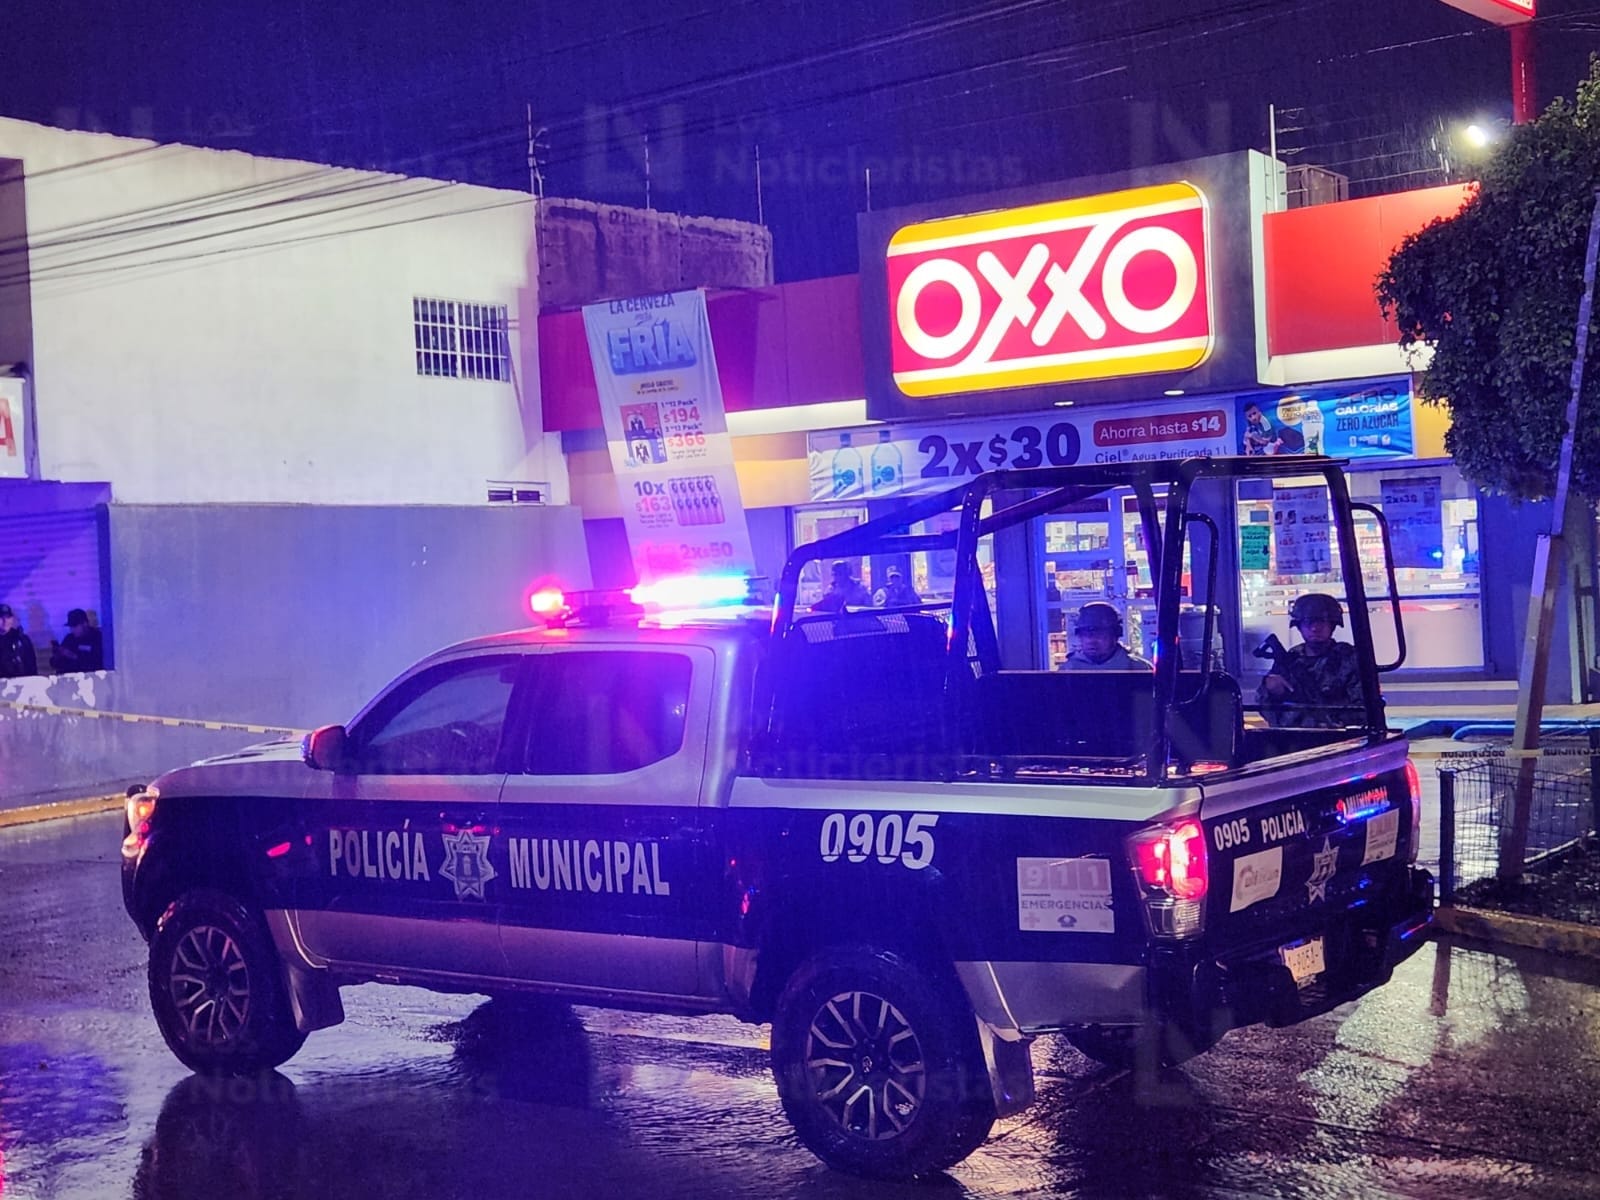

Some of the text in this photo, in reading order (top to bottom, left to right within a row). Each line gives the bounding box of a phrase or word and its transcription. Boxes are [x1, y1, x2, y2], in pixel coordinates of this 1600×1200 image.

[897, 225, 1197, 361] OXXO
[608, 319, 696, 371] FRÍA
[663, 406, 700, 423] $194
[1336, 416, 1360, 432] ZERO
[668, 431, 705, 448] $366
[1100, 415, 1221, 441] Ahorra hasta $14
[918, 423, 1081, 479] 2x$30
[634, 480, 666, 496] 10x
[635, 496, 671, 512] $163
[1214, 804, 1304, 851] 0905 POLICÍA
[820, 813, 939, 870] 0905
[328, 818, 670, 896] POLICÍA MUNICIPAL
[1023, 864, 1100, 887] 911
